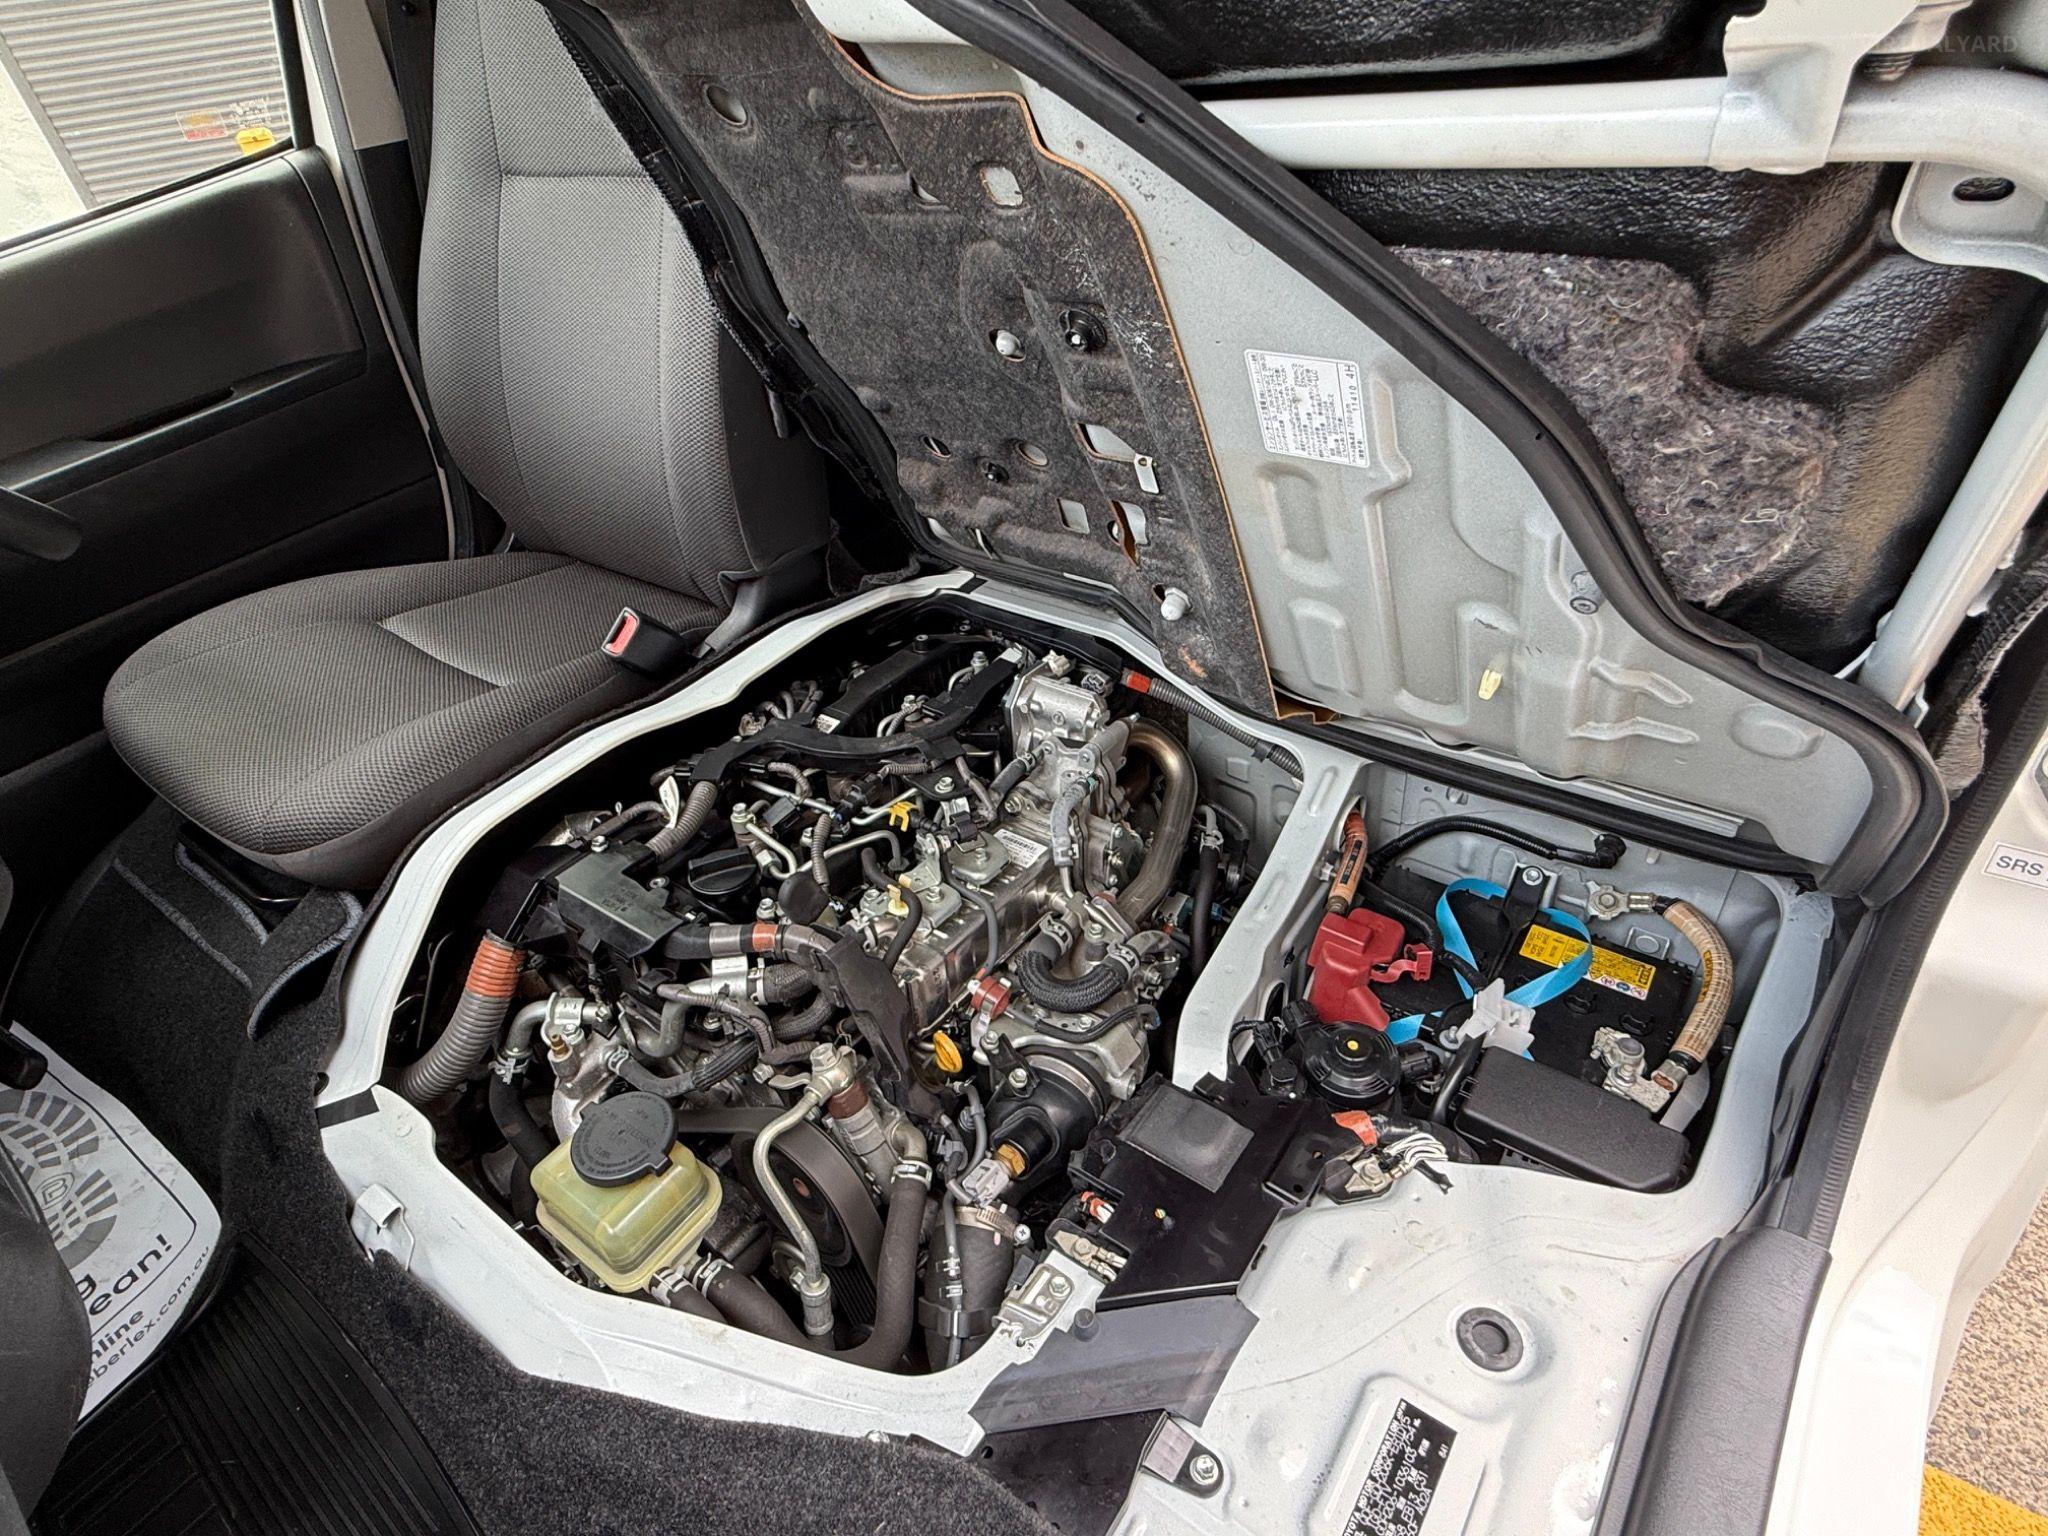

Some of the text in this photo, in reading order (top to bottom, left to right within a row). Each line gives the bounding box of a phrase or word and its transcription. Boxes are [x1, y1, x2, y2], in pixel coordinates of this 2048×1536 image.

[1996, 856, 2044, 875] SRS
[89, 1234, 172, 1316] ean!
[1357, 1480, 1373, 1508] MOTOR
[1371, 1420, 1399, 1476] CORPORATION
[1414, 1471, 1428, 1490] C31
